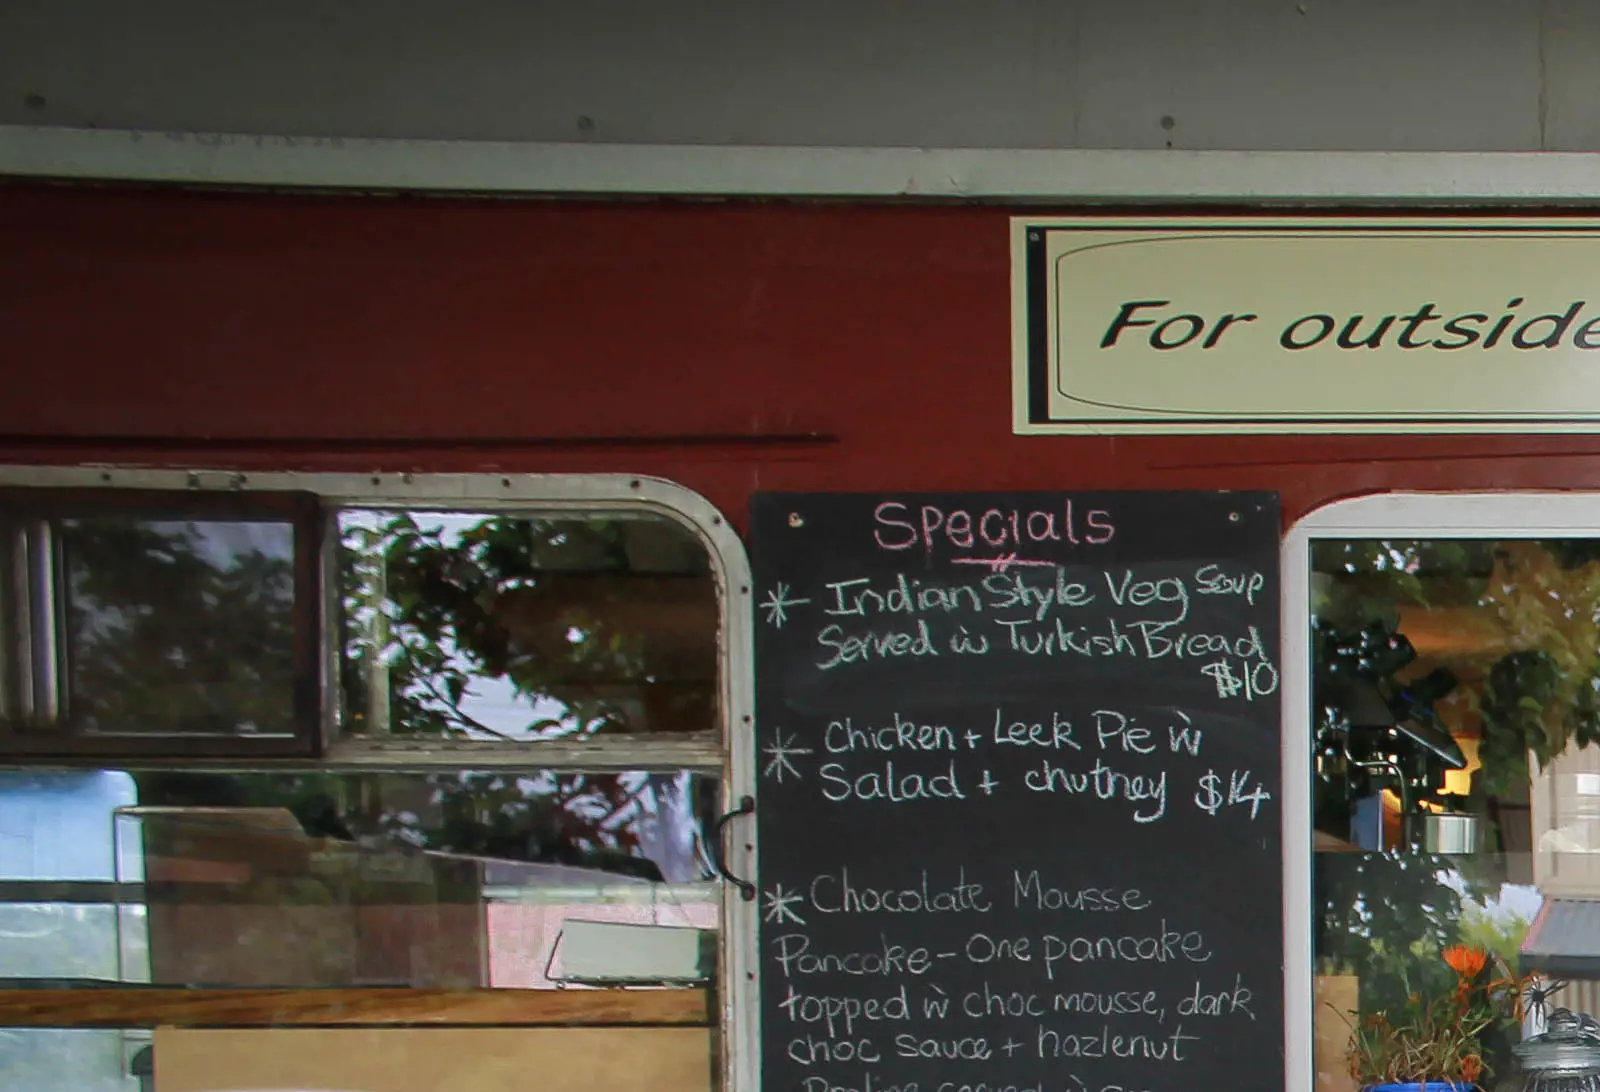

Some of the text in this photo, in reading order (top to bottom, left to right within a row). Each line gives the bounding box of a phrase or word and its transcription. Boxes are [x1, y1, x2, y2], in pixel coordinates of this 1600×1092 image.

[1100, 299, 1257, 350] For
[824, 563, 1264, 625] Indian Style Veg Soup
[816, 619, 938, 670] Served
[995, 618, 1135, 657] Turkish
[1127, 620, 1266, 661] Bread
[1201, 660, 1279, 701] $10
[824, 713, 958, 755] Chicken
[993, 708, 1082, 751] Leek
[1091, 709, 1156, 753] Pie
[820, 760, 966, 803] Salad
[1024, 758, 1166, 823] chutney
[1194, 768, 1271, 820] $14
[810, 866, 1153, 914] Chocolate Mousse
[1043, 918, 1213, 980] pancake
[778, 986, 910, 1038] topped
[962, 981, 1045, 1016] choc
[1054, 988, 1167, 1024] mousse,
[1176, 972, 1257, 1021] dark
[787, 1032, 881, 1065] choc
[1038, 1022, 1201, 1062] hazlenut
